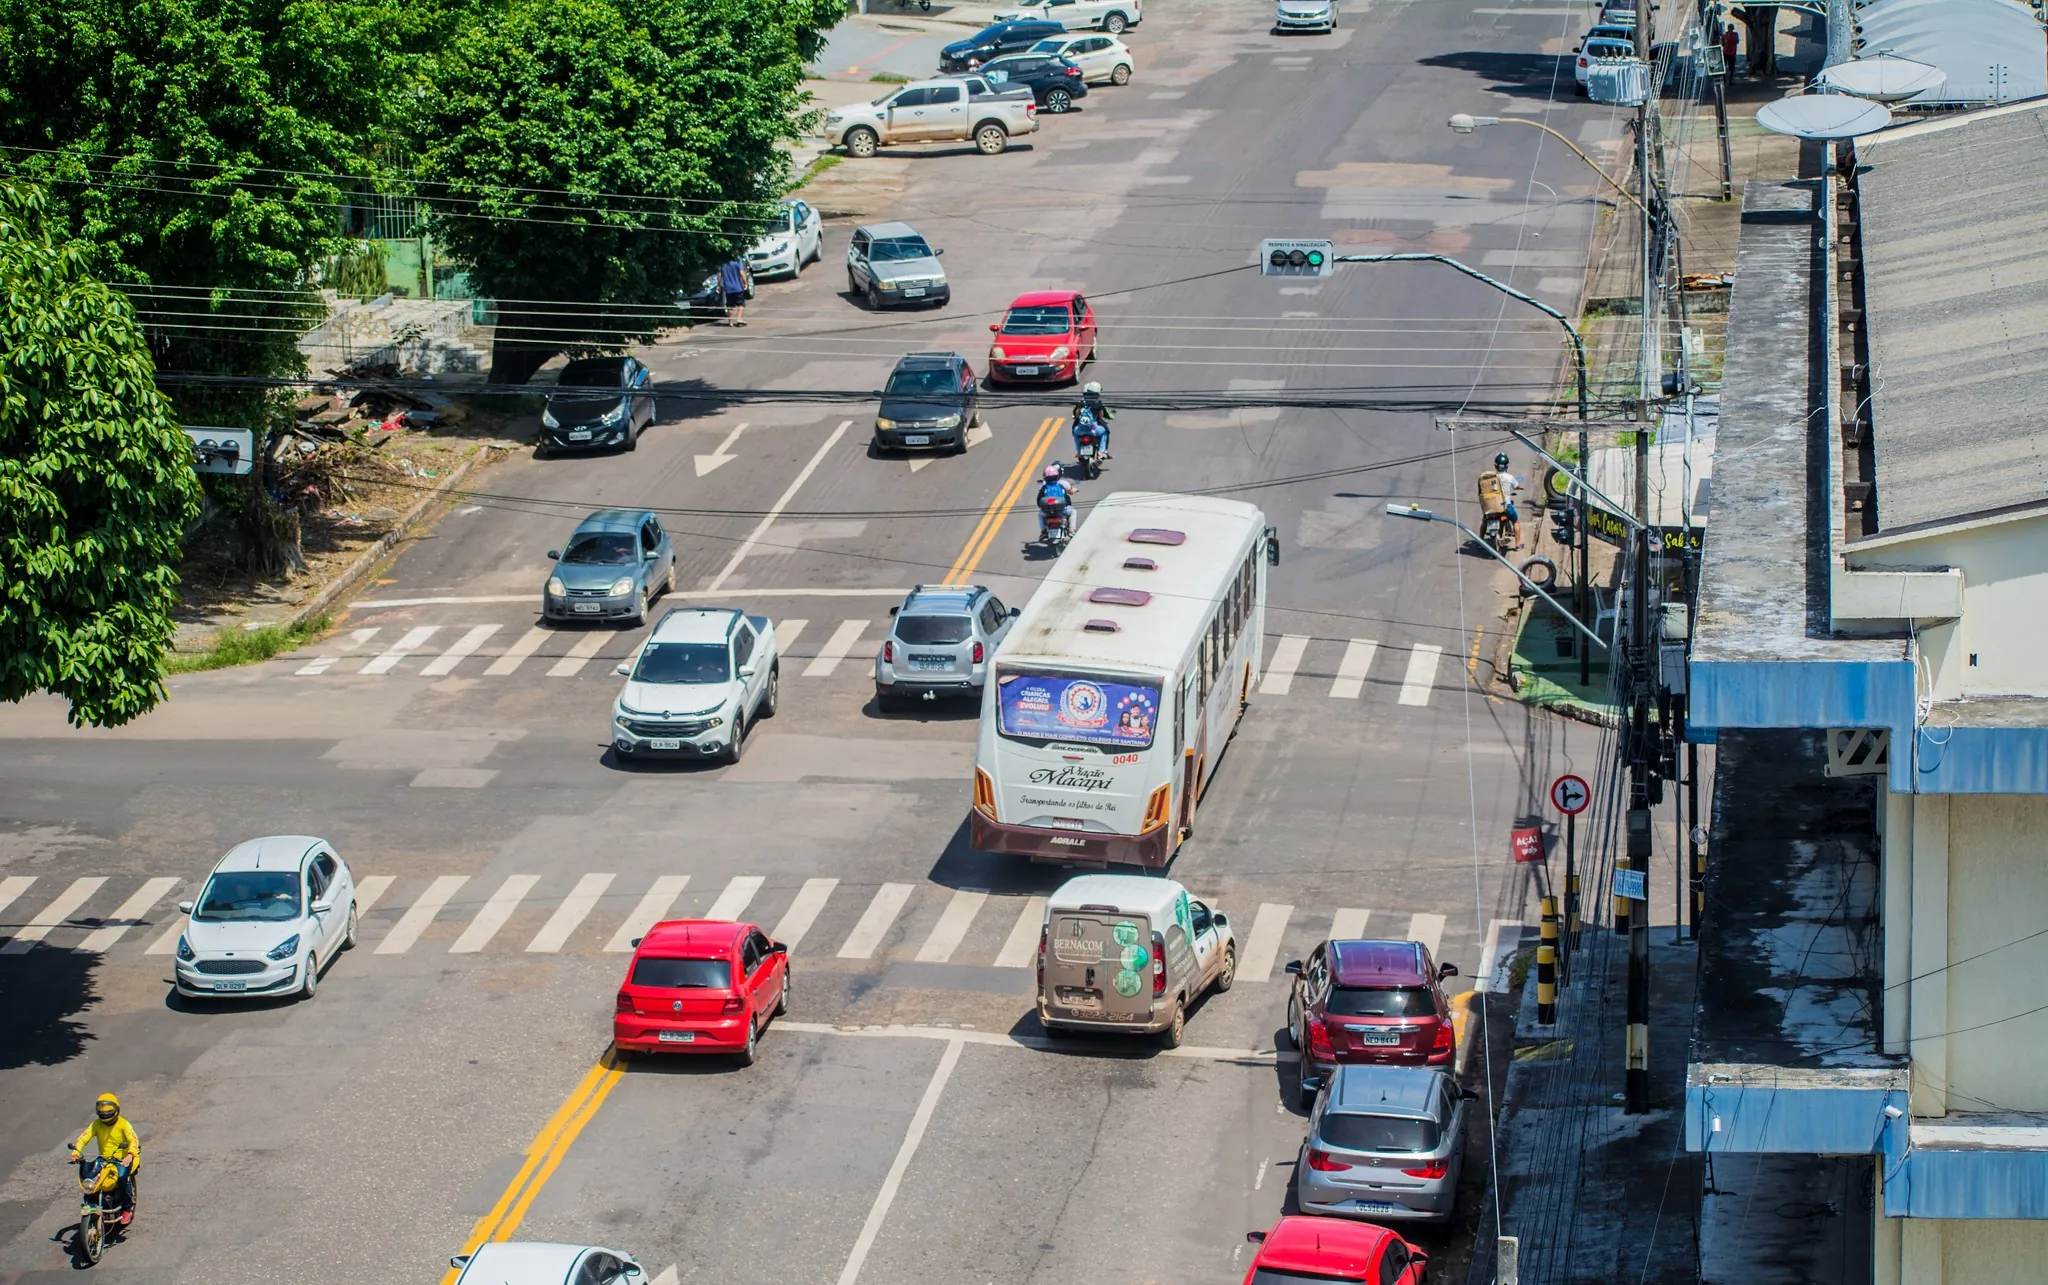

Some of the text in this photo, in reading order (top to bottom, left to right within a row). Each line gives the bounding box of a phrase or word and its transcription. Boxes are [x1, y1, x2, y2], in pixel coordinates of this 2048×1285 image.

[1665, 532, 1700, 549] Sabr
[1113, 754, 1138, 764] 0040
[1062, 765, 1105, 778] Viação
[1029, 768, 1114, 791] Macapá
[1020, 795, 1067, 807] Transportando
[1076, 800, 1094, 810] filhos
[1104, 803, 1117, 811] Rei
[1050, 837, 1086, 847] AGRALE
[1053, 939, 1103, 951] BERNACOM
[1079, 1010, 1134, 1021] 3222-2164
